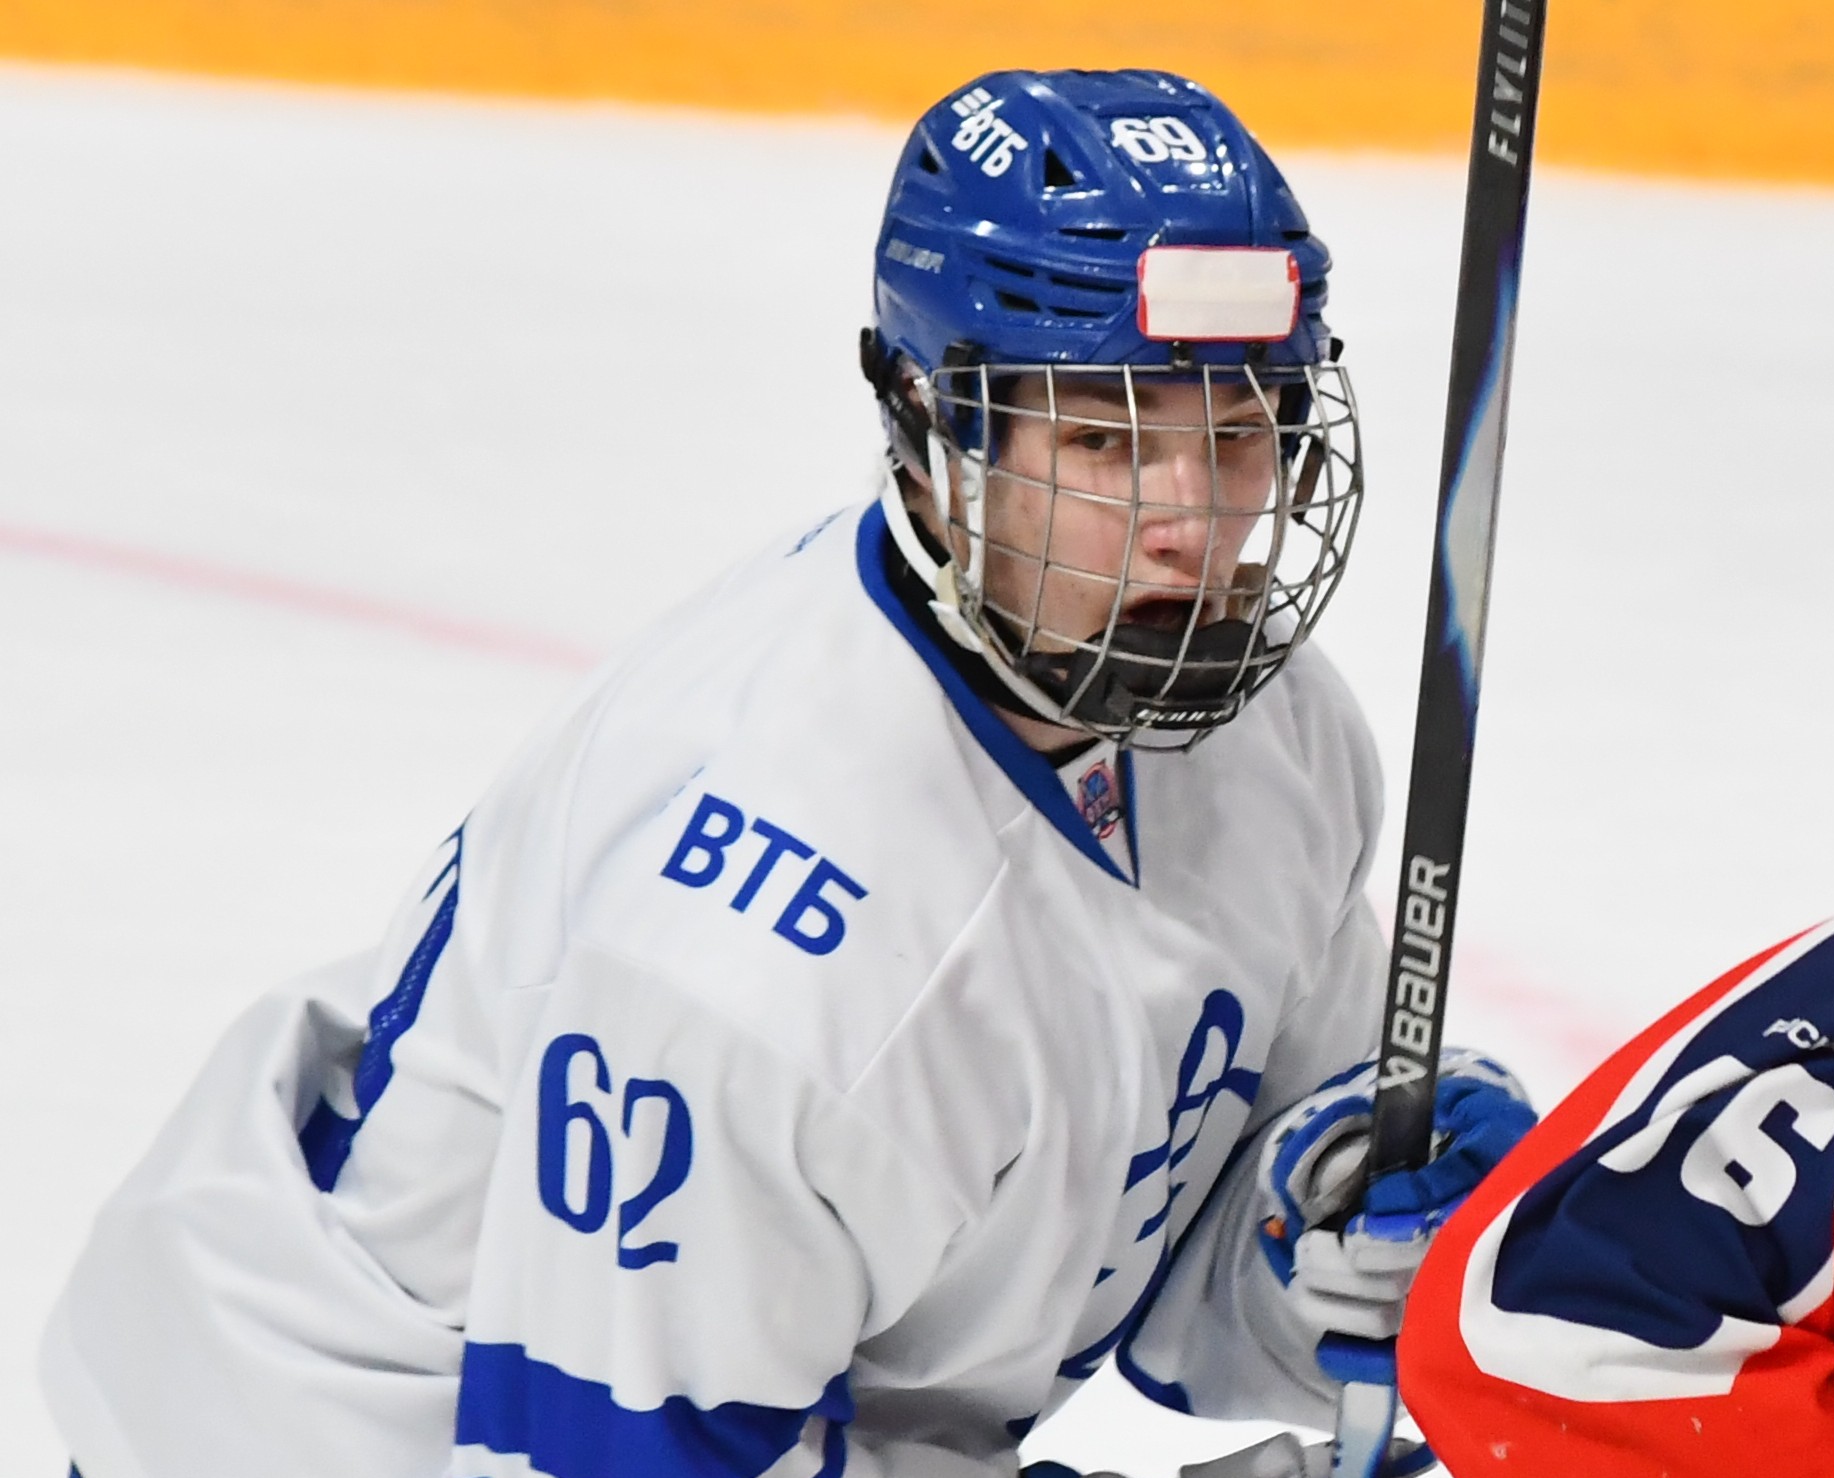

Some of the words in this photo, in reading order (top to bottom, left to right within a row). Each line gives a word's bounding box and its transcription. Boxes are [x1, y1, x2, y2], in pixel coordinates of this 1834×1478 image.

[951, 107, 1029, 178] ВТБ
[1110, 115, 1207, 163] 69
[1487, 0, 1531, 166] FLYLIT
[659, 792, 869, 957] ВТБ
[537, 1032, 694, 1270] 62
